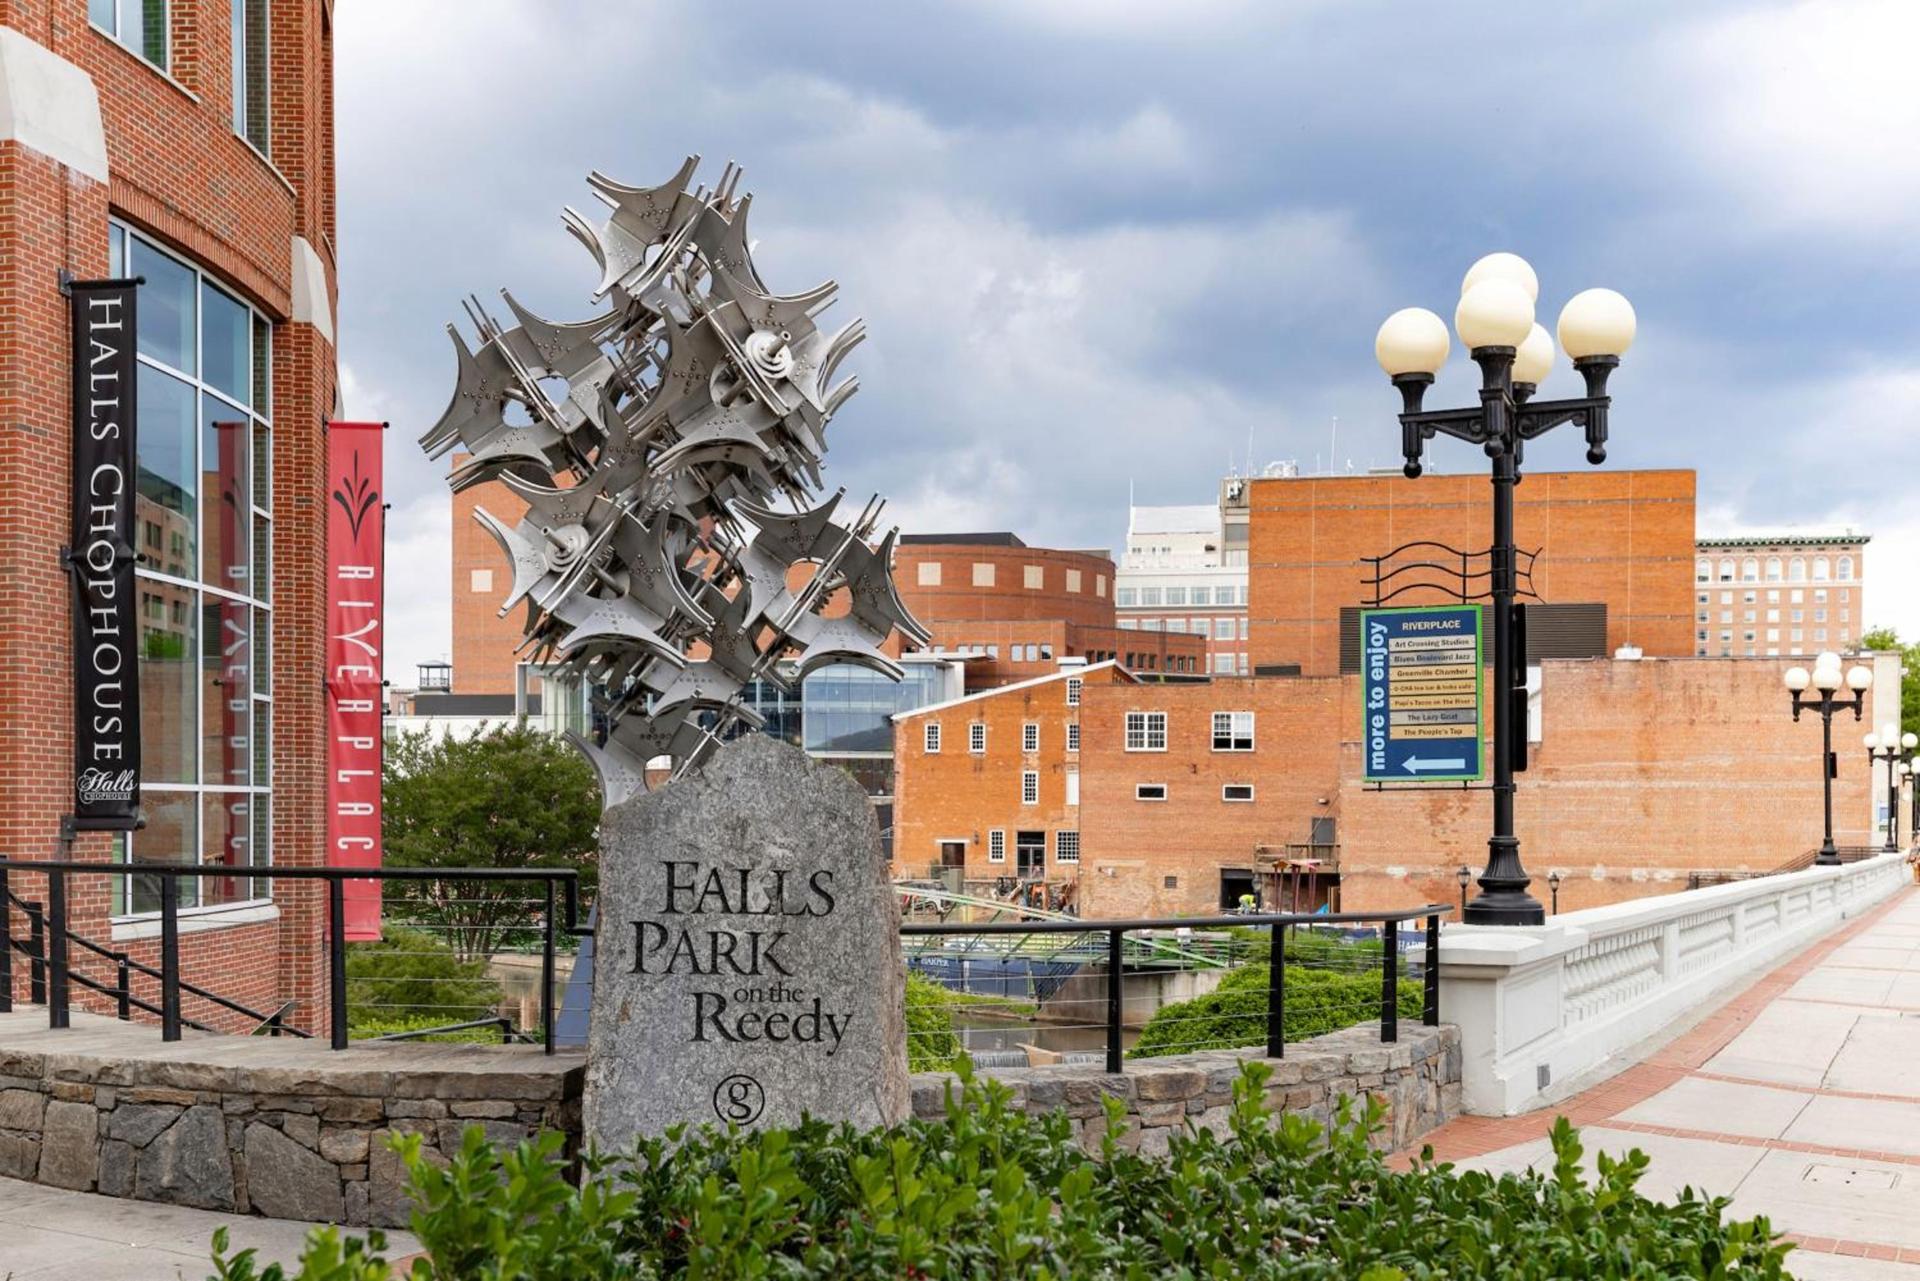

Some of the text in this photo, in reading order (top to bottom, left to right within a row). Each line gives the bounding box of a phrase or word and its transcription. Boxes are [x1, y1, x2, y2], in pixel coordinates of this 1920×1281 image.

[87, 296, 124, 760] HALLS CHOPHOUSE
[1402, 619, 1461, 631] RIVERPLACE
[1407, 639, 1440, 648] Crossing
[1441, 637, 1470, 646] Studios
[1455, 652, 1471, 660] Jazz
[1397, 667, 1469, 677] Greenville Chamber
[1367, 621, 1388, 770] more to enjoy
[331, 565, 378, 883] RIVERPLAC
[1422, 713, 1439, 721] Lazy
[1440, 712, 1458, 720] Goat
[1404, 727, 1463, 738] The People's Tap
[77, 767, 138, 803] Halls
[659, 861, 834, 917] FALLS
[628, 920, 794, 977] PARK
[733, 981, 804, 1003] on the
[690, 990, 853, 1057] Reedy
